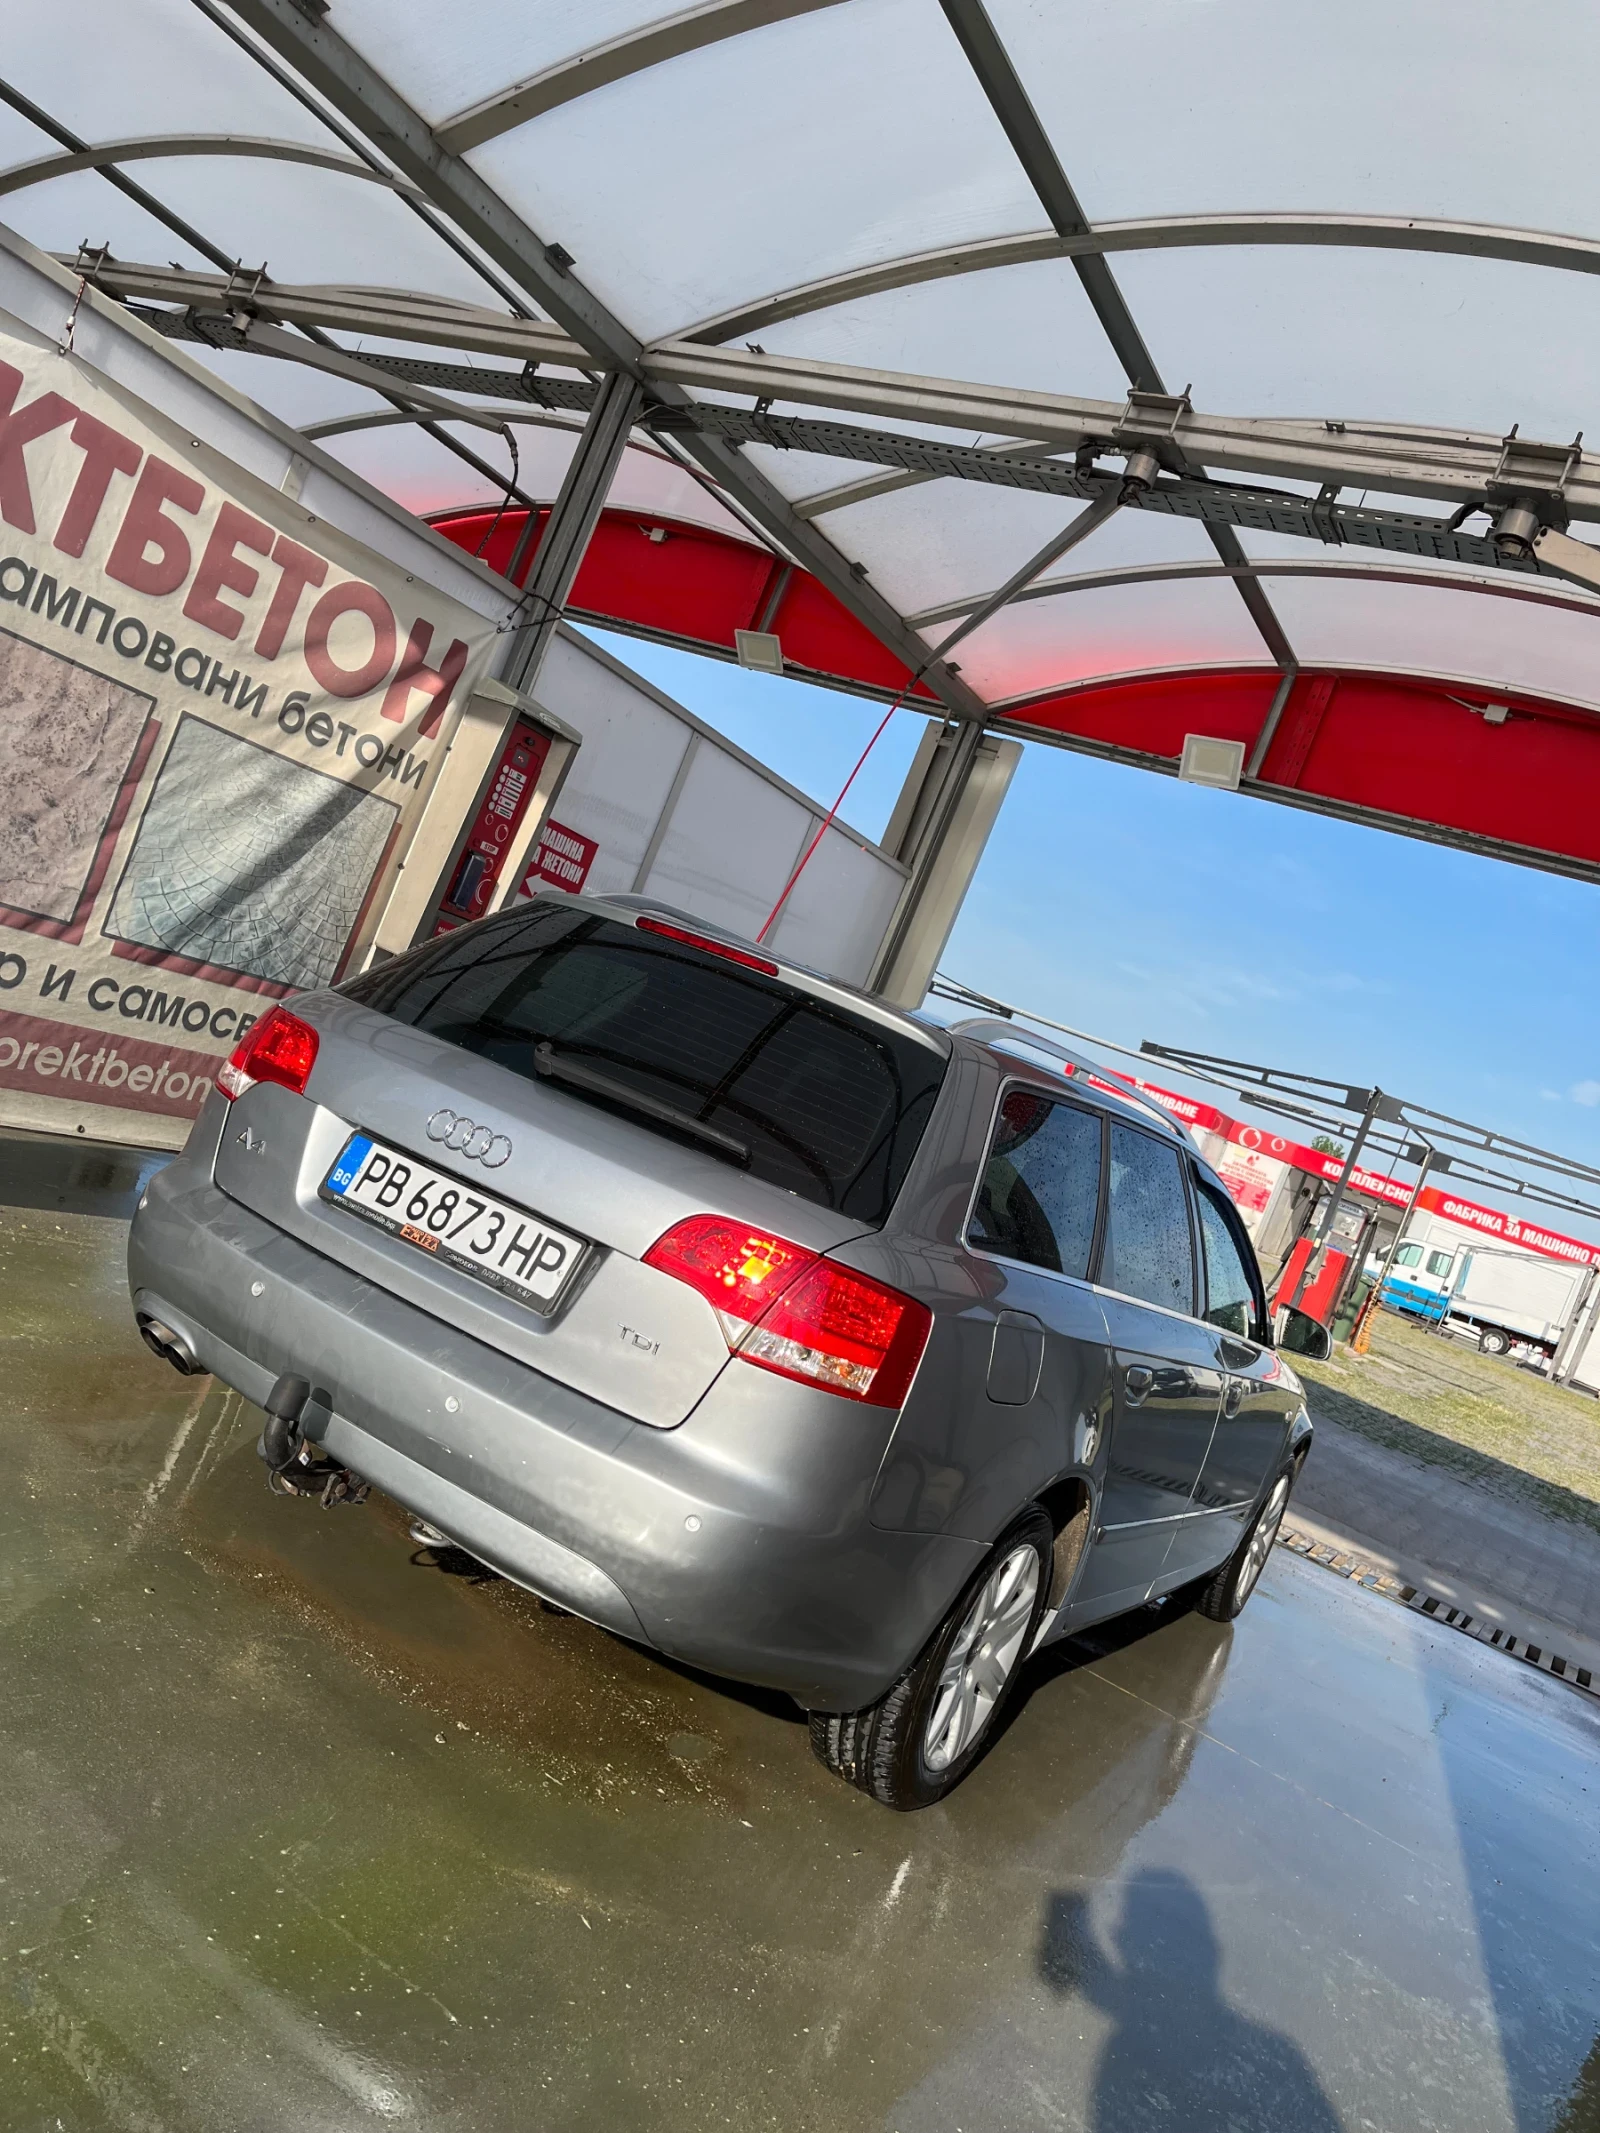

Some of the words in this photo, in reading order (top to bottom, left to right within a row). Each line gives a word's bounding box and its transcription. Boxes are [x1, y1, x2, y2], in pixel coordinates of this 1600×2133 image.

[278, 691, 428, 789] бетони
[484, 843, 496, 853] STOP
[540, 826, 585, 862] МАШИНА
[541, 850, 584, 884] ЖЕТОНИ
[39, 964, 77, 1001] и
[1135, 1084, 1199, 1119] МИВАНЕ
[235, 1127, 266, 1155] A4
[333, 1169, 352, 1187] BG
[1322, 1160, 1412, 1204] КОПЛЕКСНО
[354, 1153, 411, 1208] PB
[405, 1180, 506, 1255] 6873
[497, 1224, 566, 1281] HP
[1443, 1200, 1503, 1232] ФАБРИКА
[1504, 1222, 1522, 1239] ЗА
[1521, 1228, 1590, 1263] МАШИННО
[617, 1322, 660, 1356] TDI
